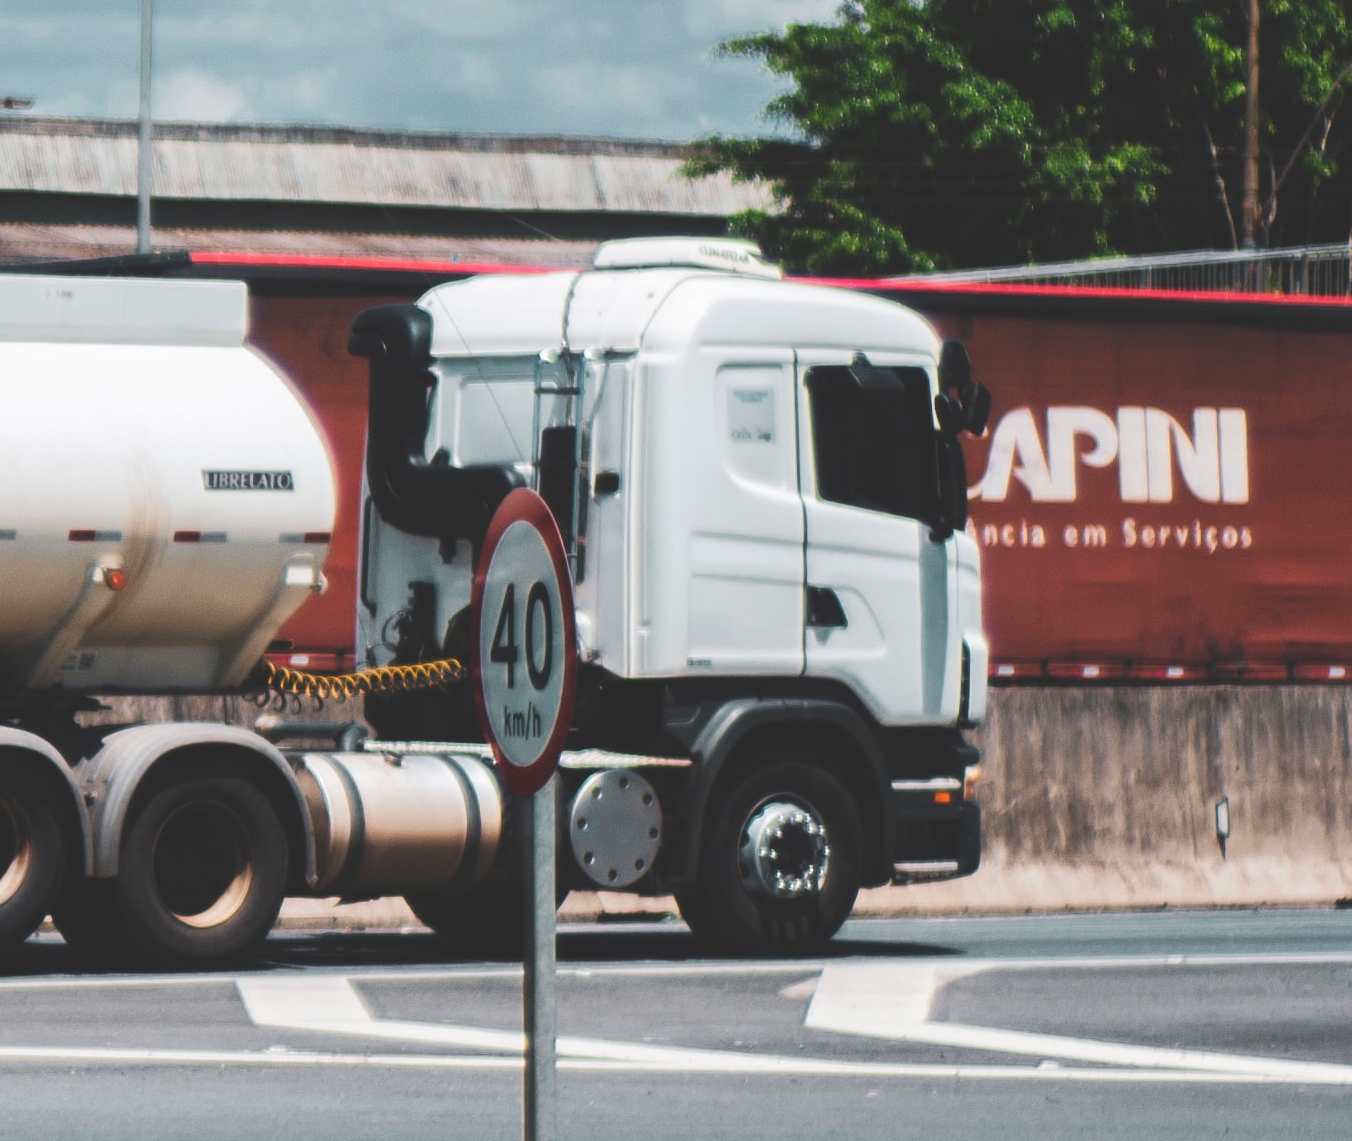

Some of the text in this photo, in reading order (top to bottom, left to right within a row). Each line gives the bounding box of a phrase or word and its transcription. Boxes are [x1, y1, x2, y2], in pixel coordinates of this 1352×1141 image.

[968, 406, 1250, 505] APINI
[205, 472, 291, 489] LIBRELATO
[1063, 523, 1107, 548] em
[1122, 516, 1253, 554] Serviços
[490, 580, 554, 691] 40
[503, 702, 541, 738] km/h
